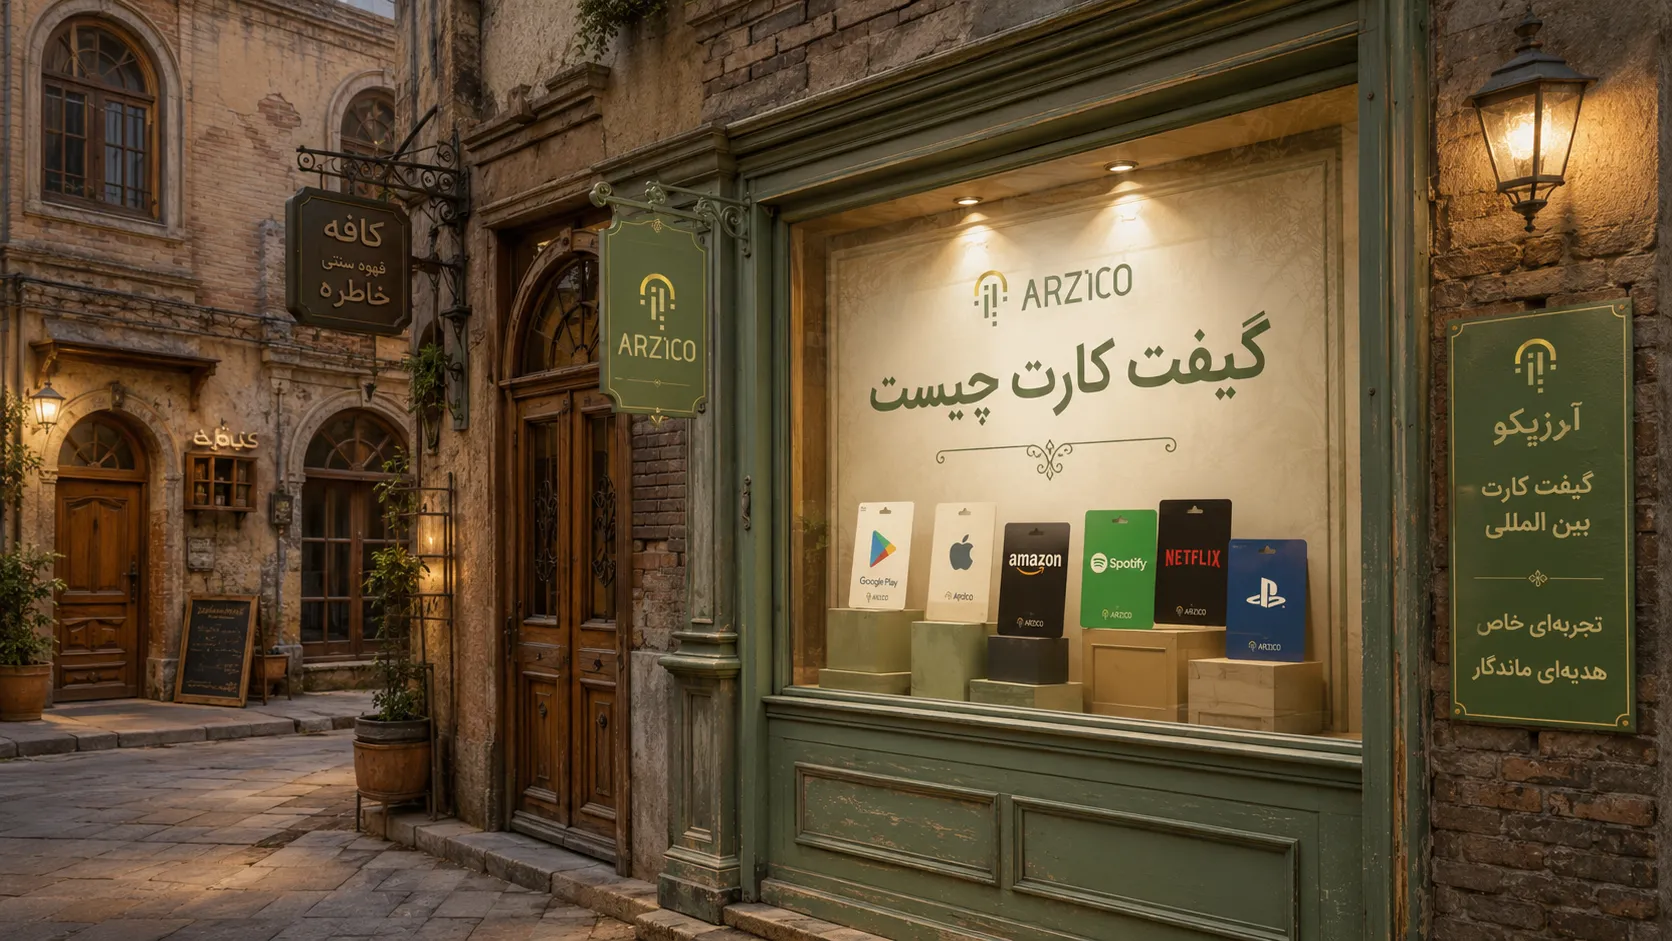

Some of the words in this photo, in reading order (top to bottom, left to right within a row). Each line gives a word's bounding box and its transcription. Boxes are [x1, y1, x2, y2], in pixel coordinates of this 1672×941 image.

[324, 214, 384, 248] کافه
[322, 256, 354, 270] سنتی
[358, 261, 386, 277] قهوه
[320, 279, 389, 308] خاطره
[1022, 264, 1132, 311] ARZICO
[618, 333, 695, 362] ARZICO
[1128, 310, 1271, 400] گیفت
[1012, 338, 1115, 416] کارت
[870, 368, 999, 426] چیست
[1482, 475, 1529, 503] کارت
[1535, 471, 1594, 499] گیفت
[1486, 512, 1545, 538] المللی
[1553, 519, 1590, 538] بین
[1008, 553, 1062, 568] amazon
[1109, 557, 1148, 572] Spotify
[1166, 549, 1220, 567] NETFLIX
[859, 575, 883, 588] Google
[885, 577, 899, 589] Play
[1477, 613, 1524, 635] خاص
[1530, 614, 1602, 638] تجربه‌ای
[1472, 655, 1531, 680] ماندگار
[1538, 660, 1607, 684] هدیه‌ای
